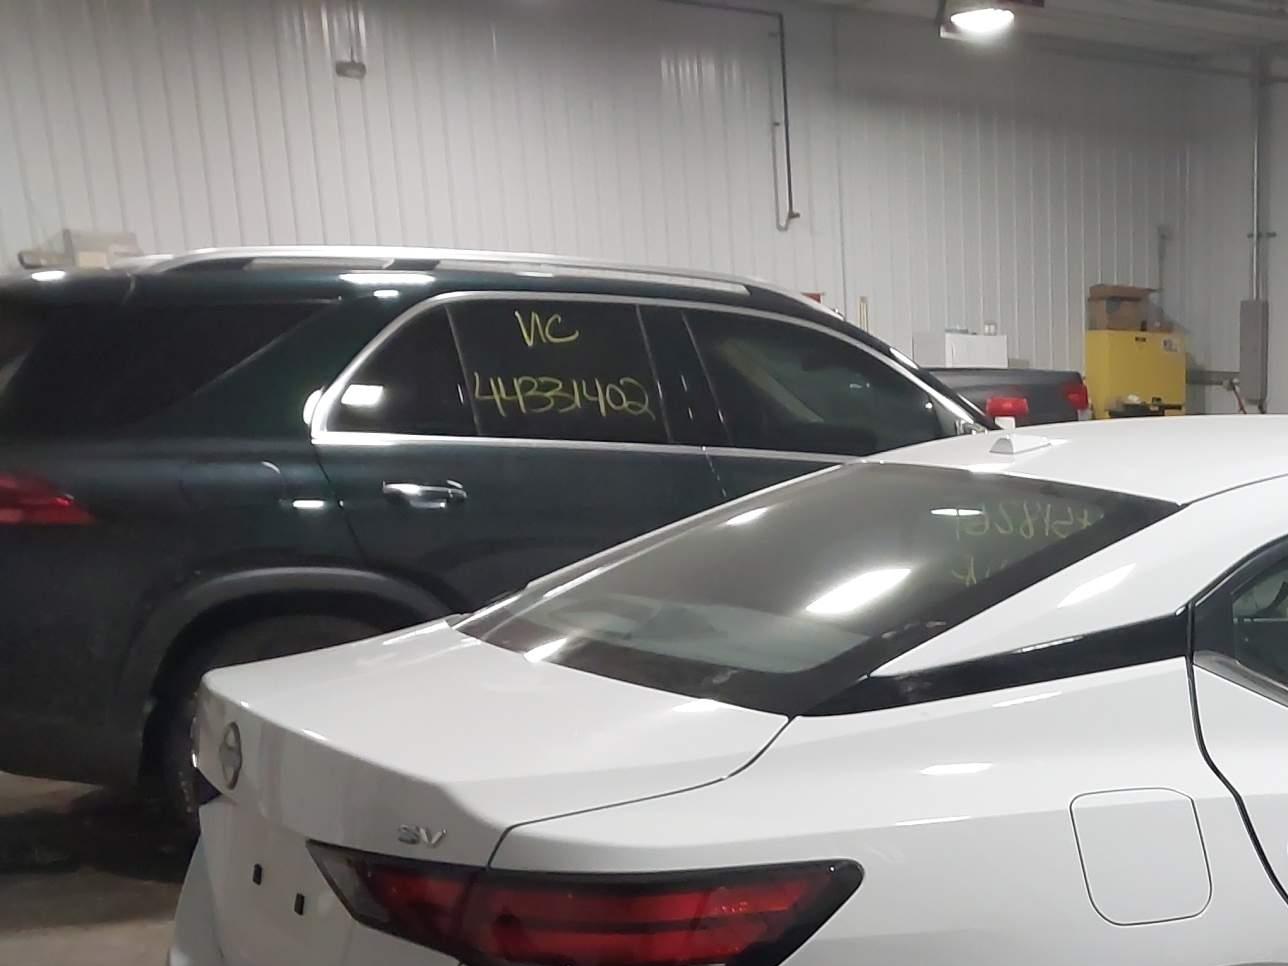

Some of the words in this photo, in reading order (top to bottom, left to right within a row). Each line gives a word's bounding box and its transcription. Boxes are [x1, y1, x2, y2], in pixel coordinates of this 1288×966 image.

[515, 310, 580, 348] VIC
[474, 371, 657, 421] 44331402
[398, 823, 448, 849] SV
